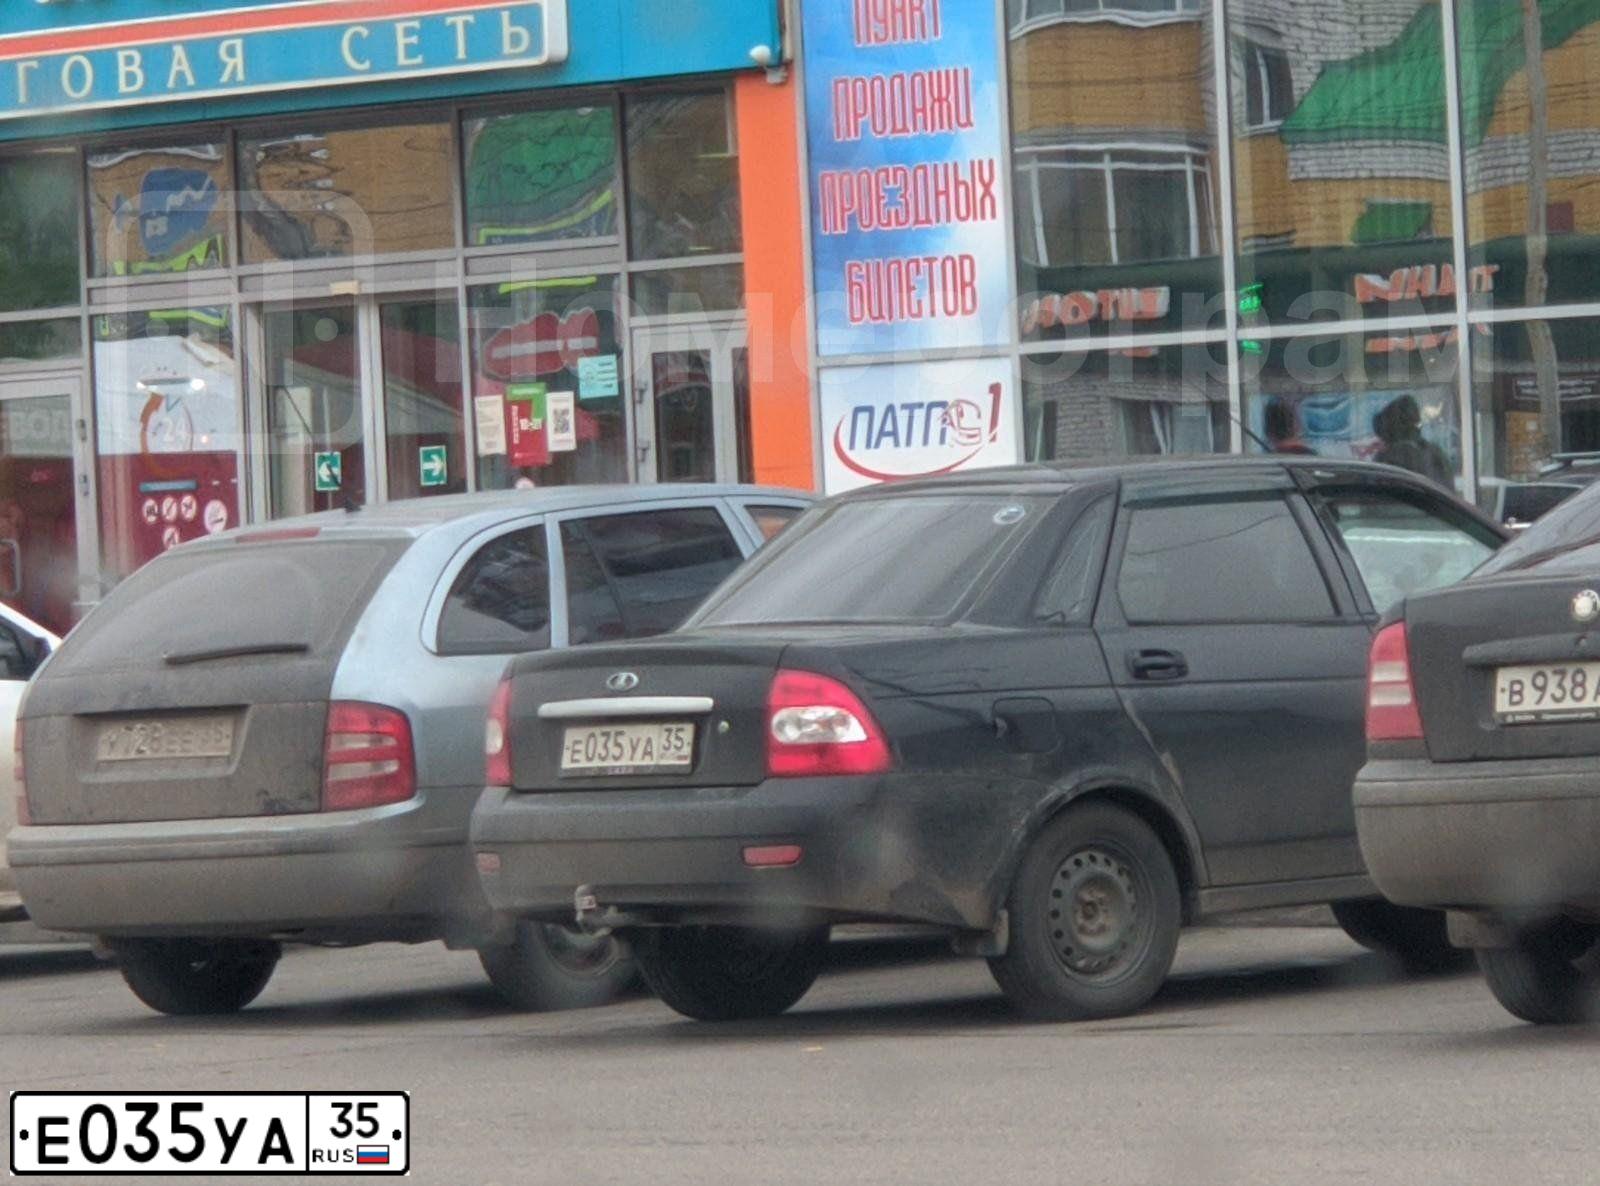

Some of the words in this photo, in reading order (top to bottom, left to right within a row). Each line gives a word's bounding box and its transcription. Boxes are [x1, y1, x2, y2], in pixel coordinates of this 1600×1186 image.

[340, 11, 532, 71] СЕТЬ
[833, 67, 974, 140] ПРОДАЖИ
[820, 158, 997, 234] ПРОЕЗДНЫХ
[846, 254, 978, 324] БИЛЕТОВ
[570, 730, 654, 763] Е035УА
[662, 727, 685, 751] 35
